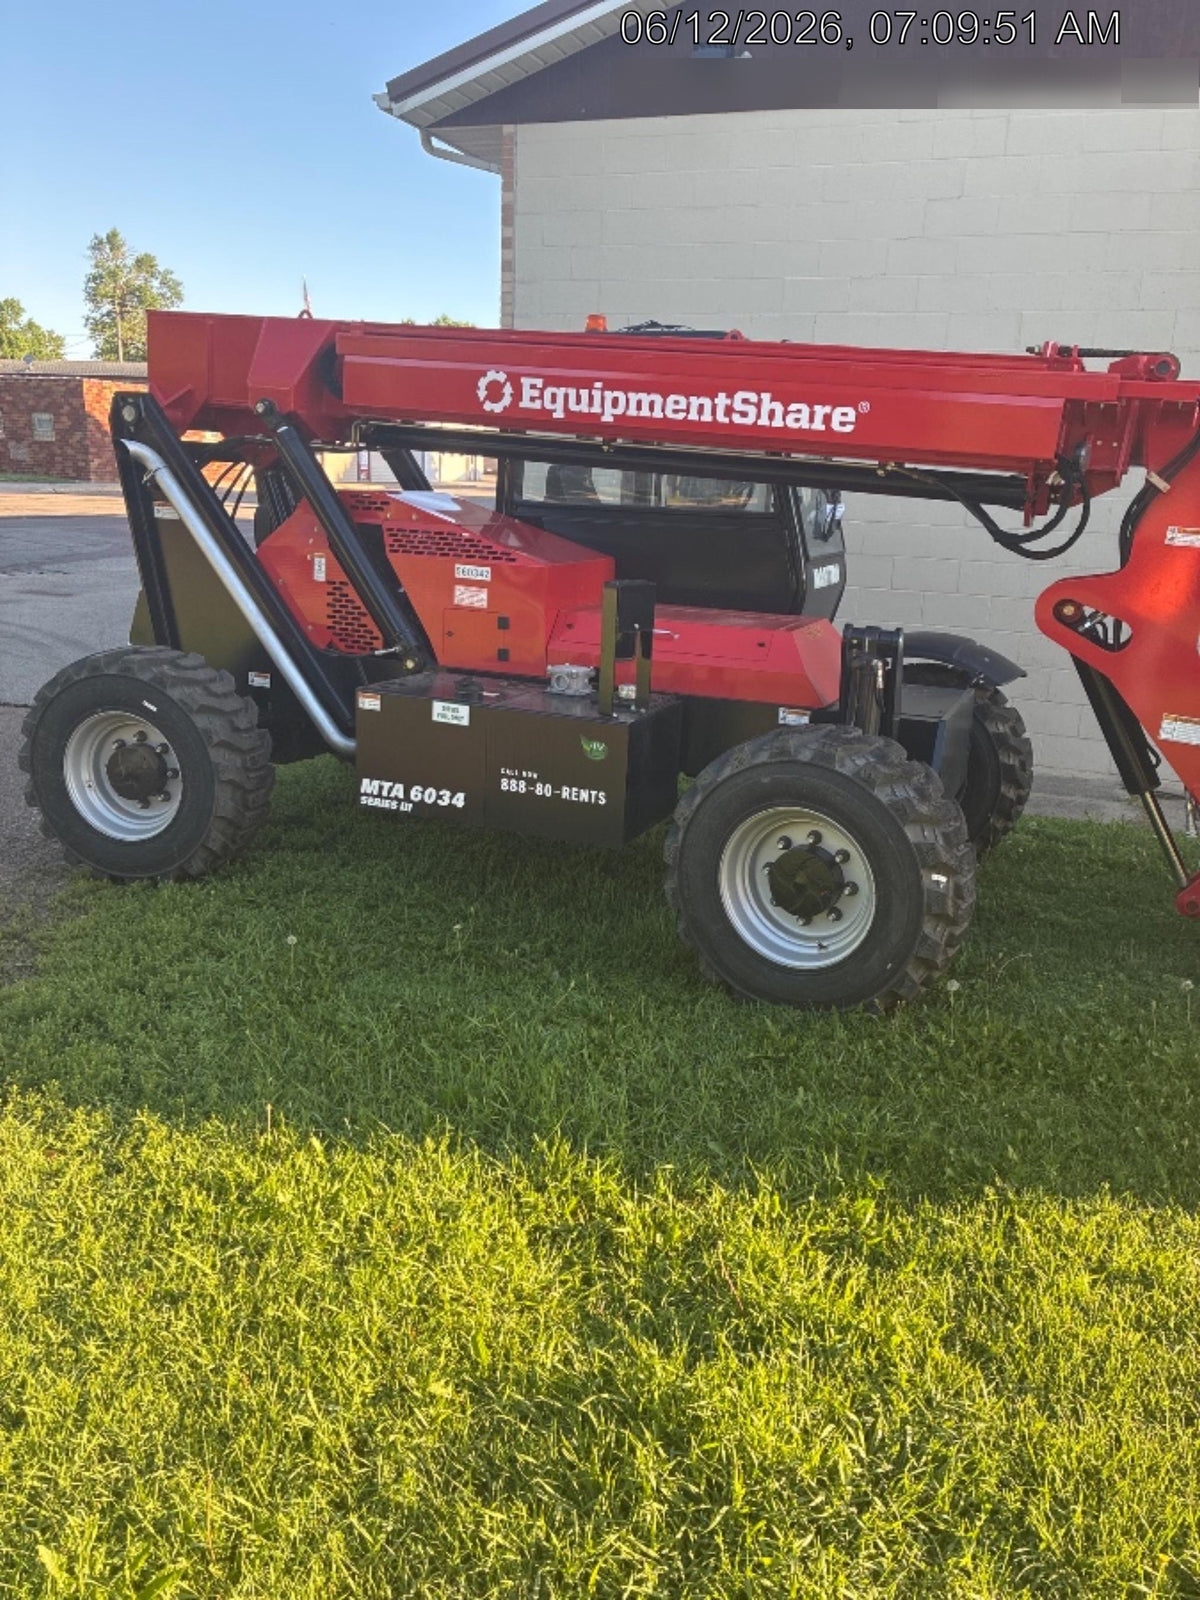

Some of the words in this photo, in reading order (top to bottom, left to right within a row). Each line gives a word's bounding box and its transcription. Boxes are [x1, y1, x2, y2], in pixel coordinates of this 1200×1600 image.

[360, 778, 405, 799] MTA
[409, 785, 466, 808] 6034
[360, 796, 399, 811] SERIES
[500, 778, 607, 806] 888-80-RENTS
